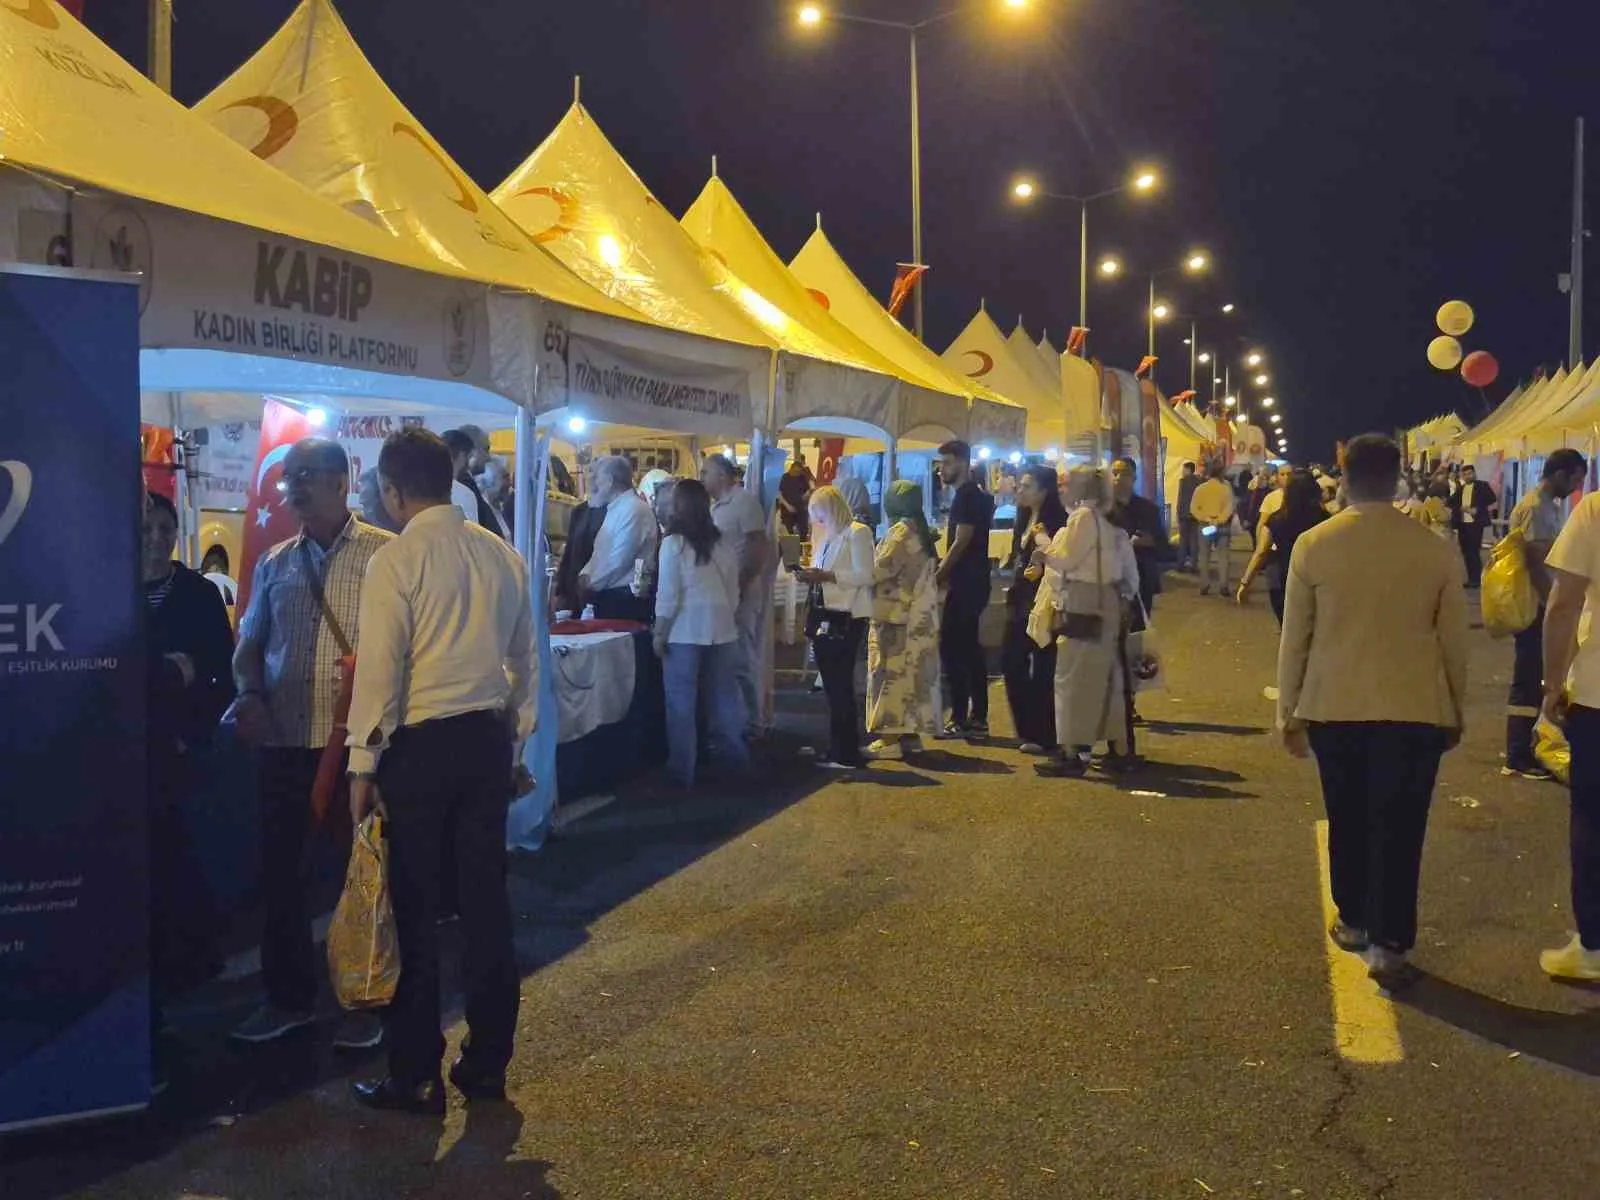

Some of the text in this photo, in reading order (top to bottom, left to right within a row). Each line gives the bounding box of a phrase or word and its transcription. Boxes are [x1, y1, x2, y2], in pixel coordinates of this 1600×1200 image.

[193, 309, 257, 346] KADIN
[262, 316, 323, 354] BİRLİĞİ
[328, 333, 418, 370] PLATFORMU
[61, 656, 120, 672] KURUMU
